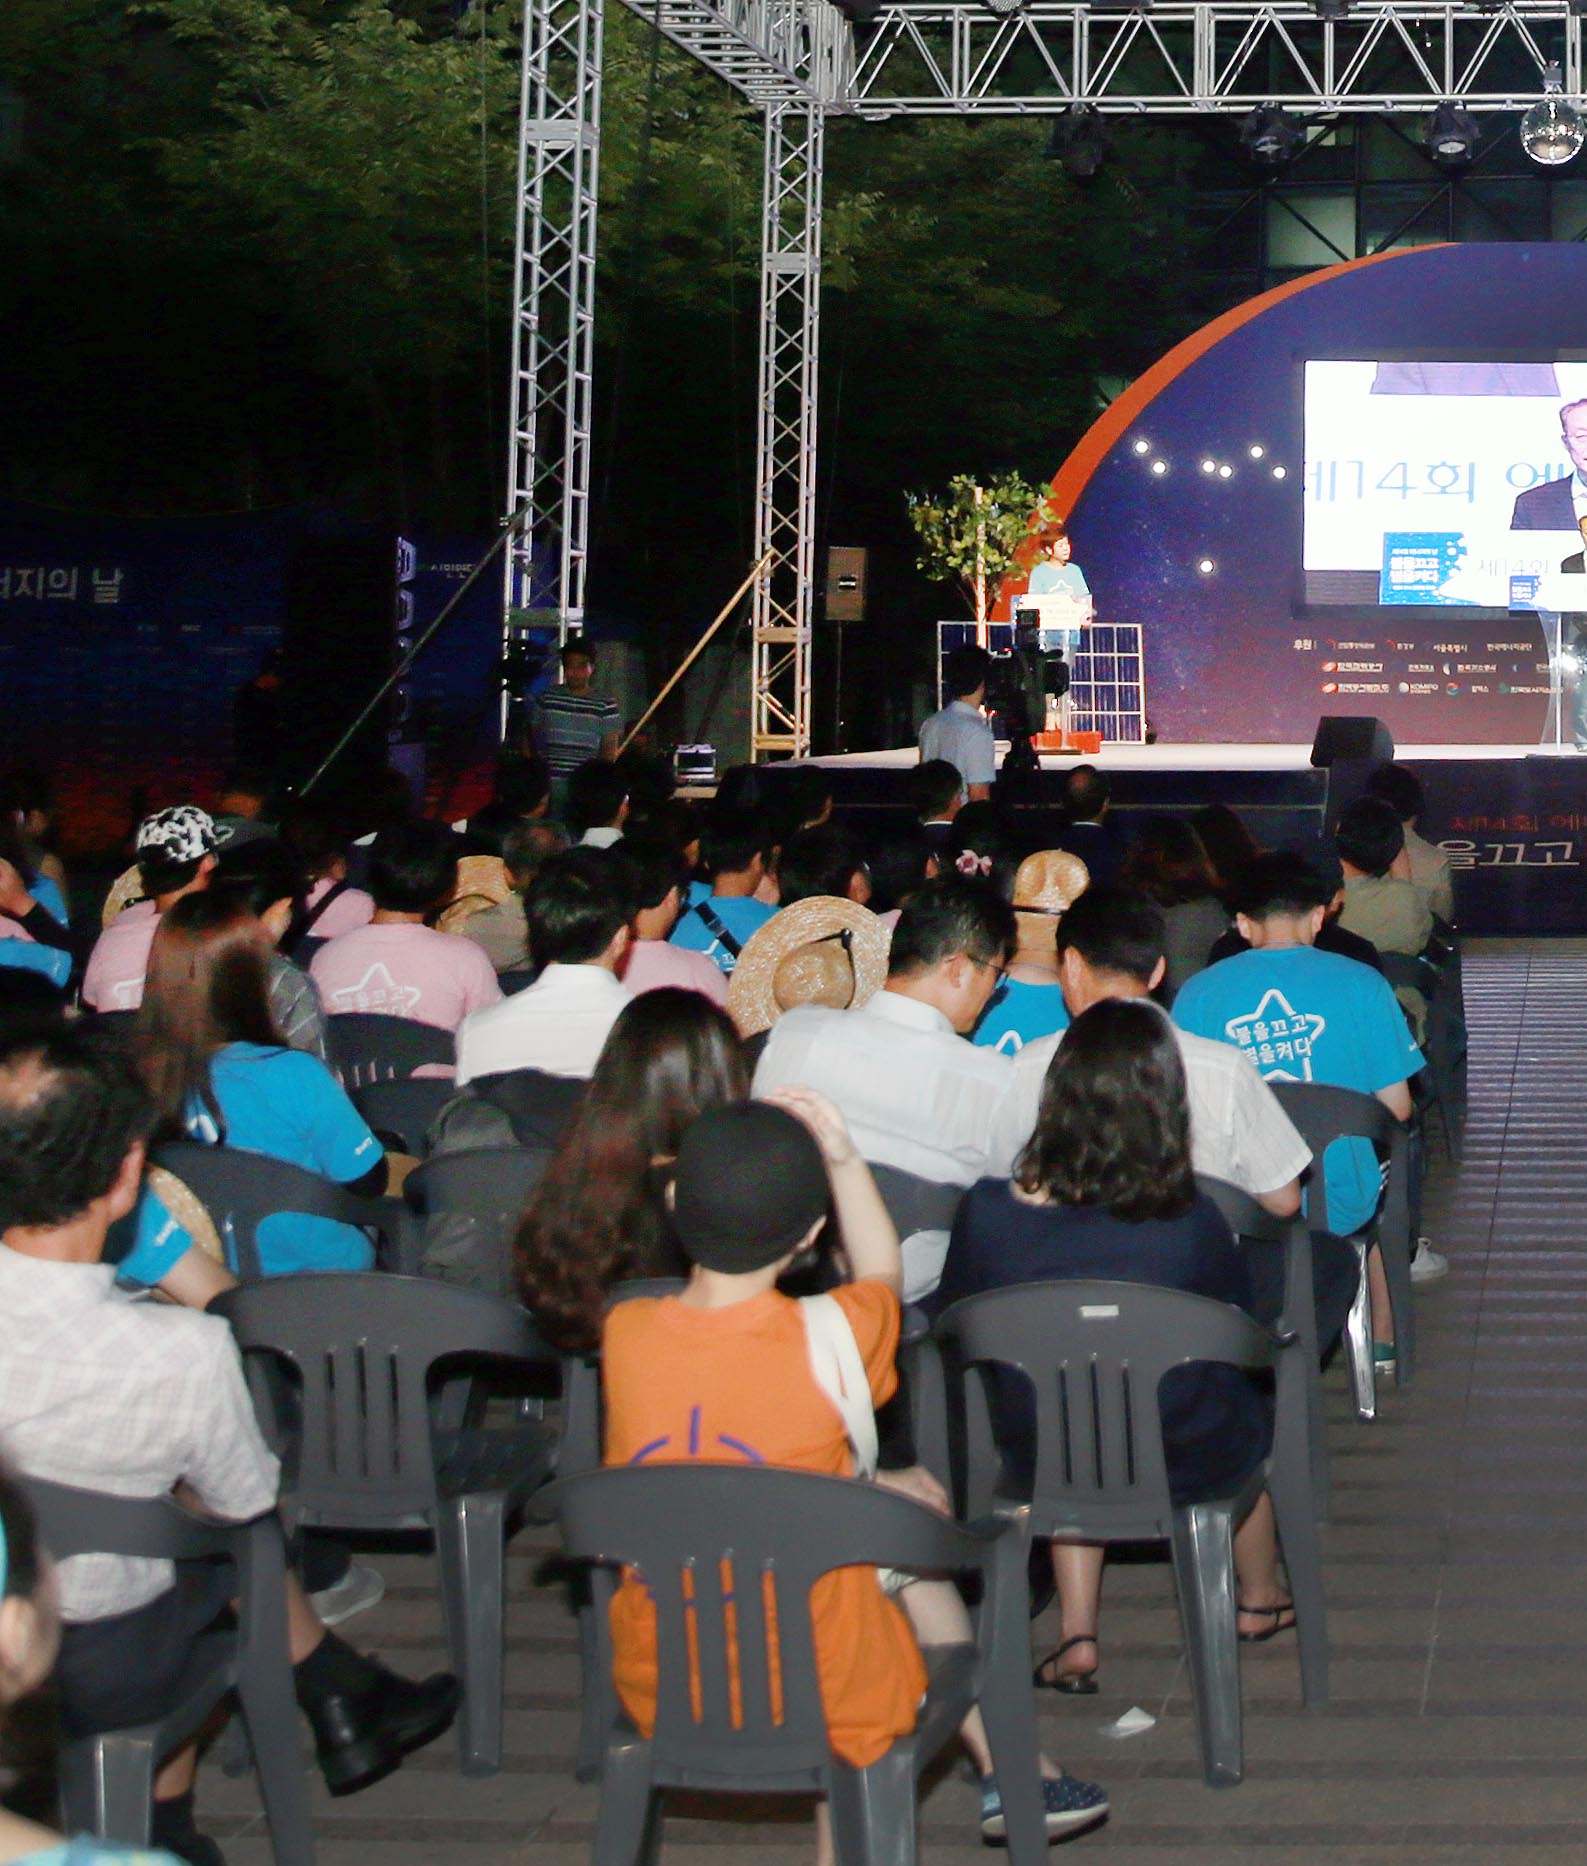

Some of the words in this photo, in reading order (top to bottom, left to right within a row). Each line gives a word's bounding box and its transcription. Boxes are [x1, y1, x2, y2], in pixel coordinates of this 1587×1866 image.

[92, 567, 125, 603] 날
[1436, 838, 1580, 869] 을끄고
[1232, 1013, 1309, 1046] 불을끄고
